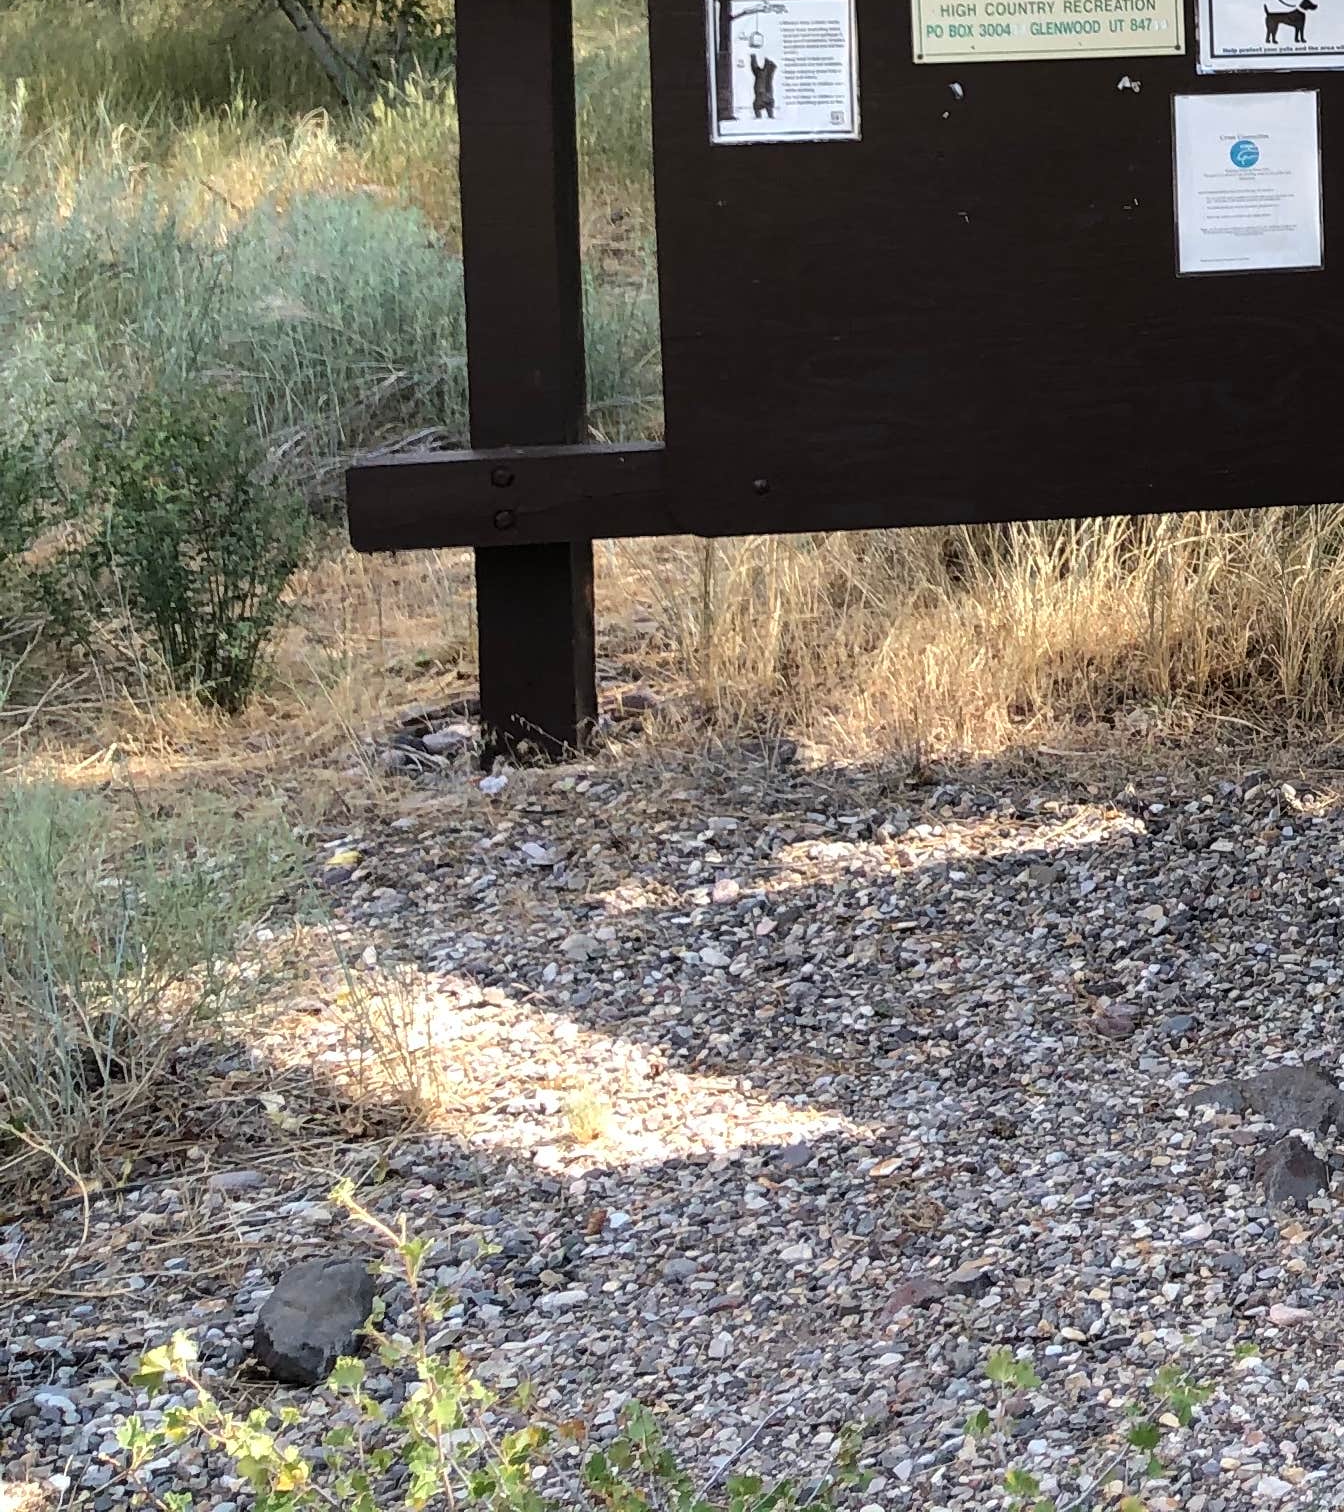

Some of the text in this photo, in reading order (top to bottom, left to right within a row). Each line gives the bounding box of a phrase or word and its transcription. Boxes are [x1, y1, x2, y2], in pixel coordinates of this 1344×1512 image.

[941, 3, 976, 17] HIGH
[985, 1, 1055, 16] COUNTRY
[927, 25, 943, 38] PO
[949, 24, 974, 37] BOX
[979, 23, 1011, 37] 3004
[1030, 21, 1100, 36] GLENWOOD
[1109, 20, 1124, 33] UT
